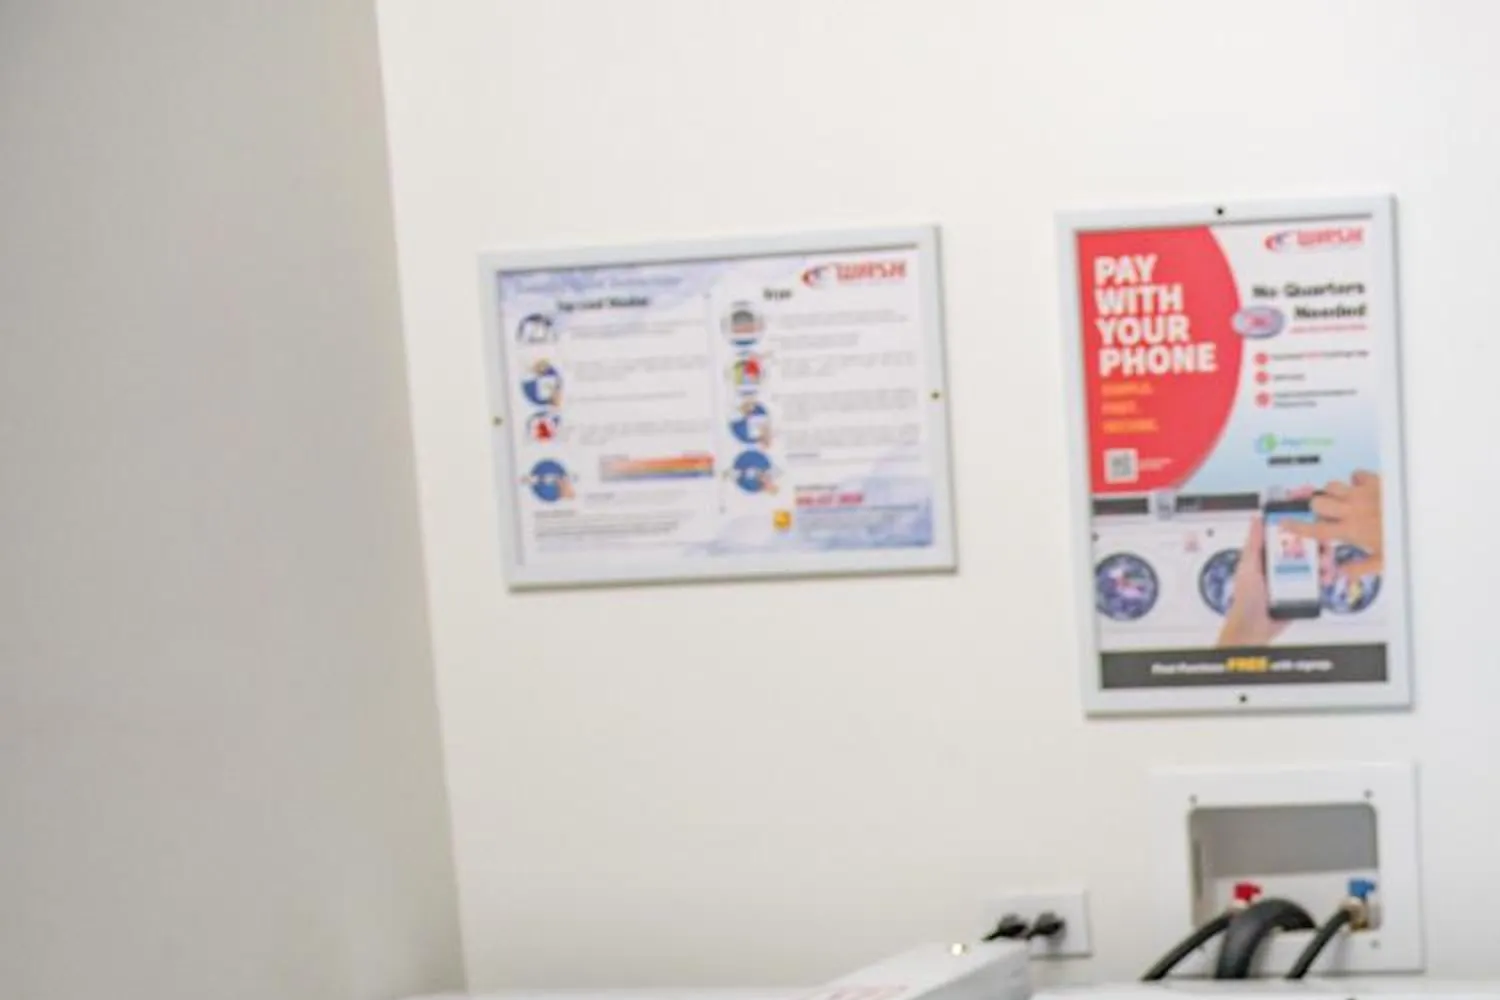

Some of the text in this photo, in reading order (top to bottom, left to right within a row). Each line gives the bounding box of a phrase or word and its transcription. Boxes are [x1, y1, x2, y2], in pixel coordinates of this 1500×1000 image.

[1094, 254, 1157, 285] PAY
[1094, 284, 1183, 315] WITH
[1283, 281, 1366, 298] Quarters
[1293, 303, 1367, 319] Needed
[1095, 314, 1190, 346] YOUR
[1098, 344, 1218, 377] PHONE
